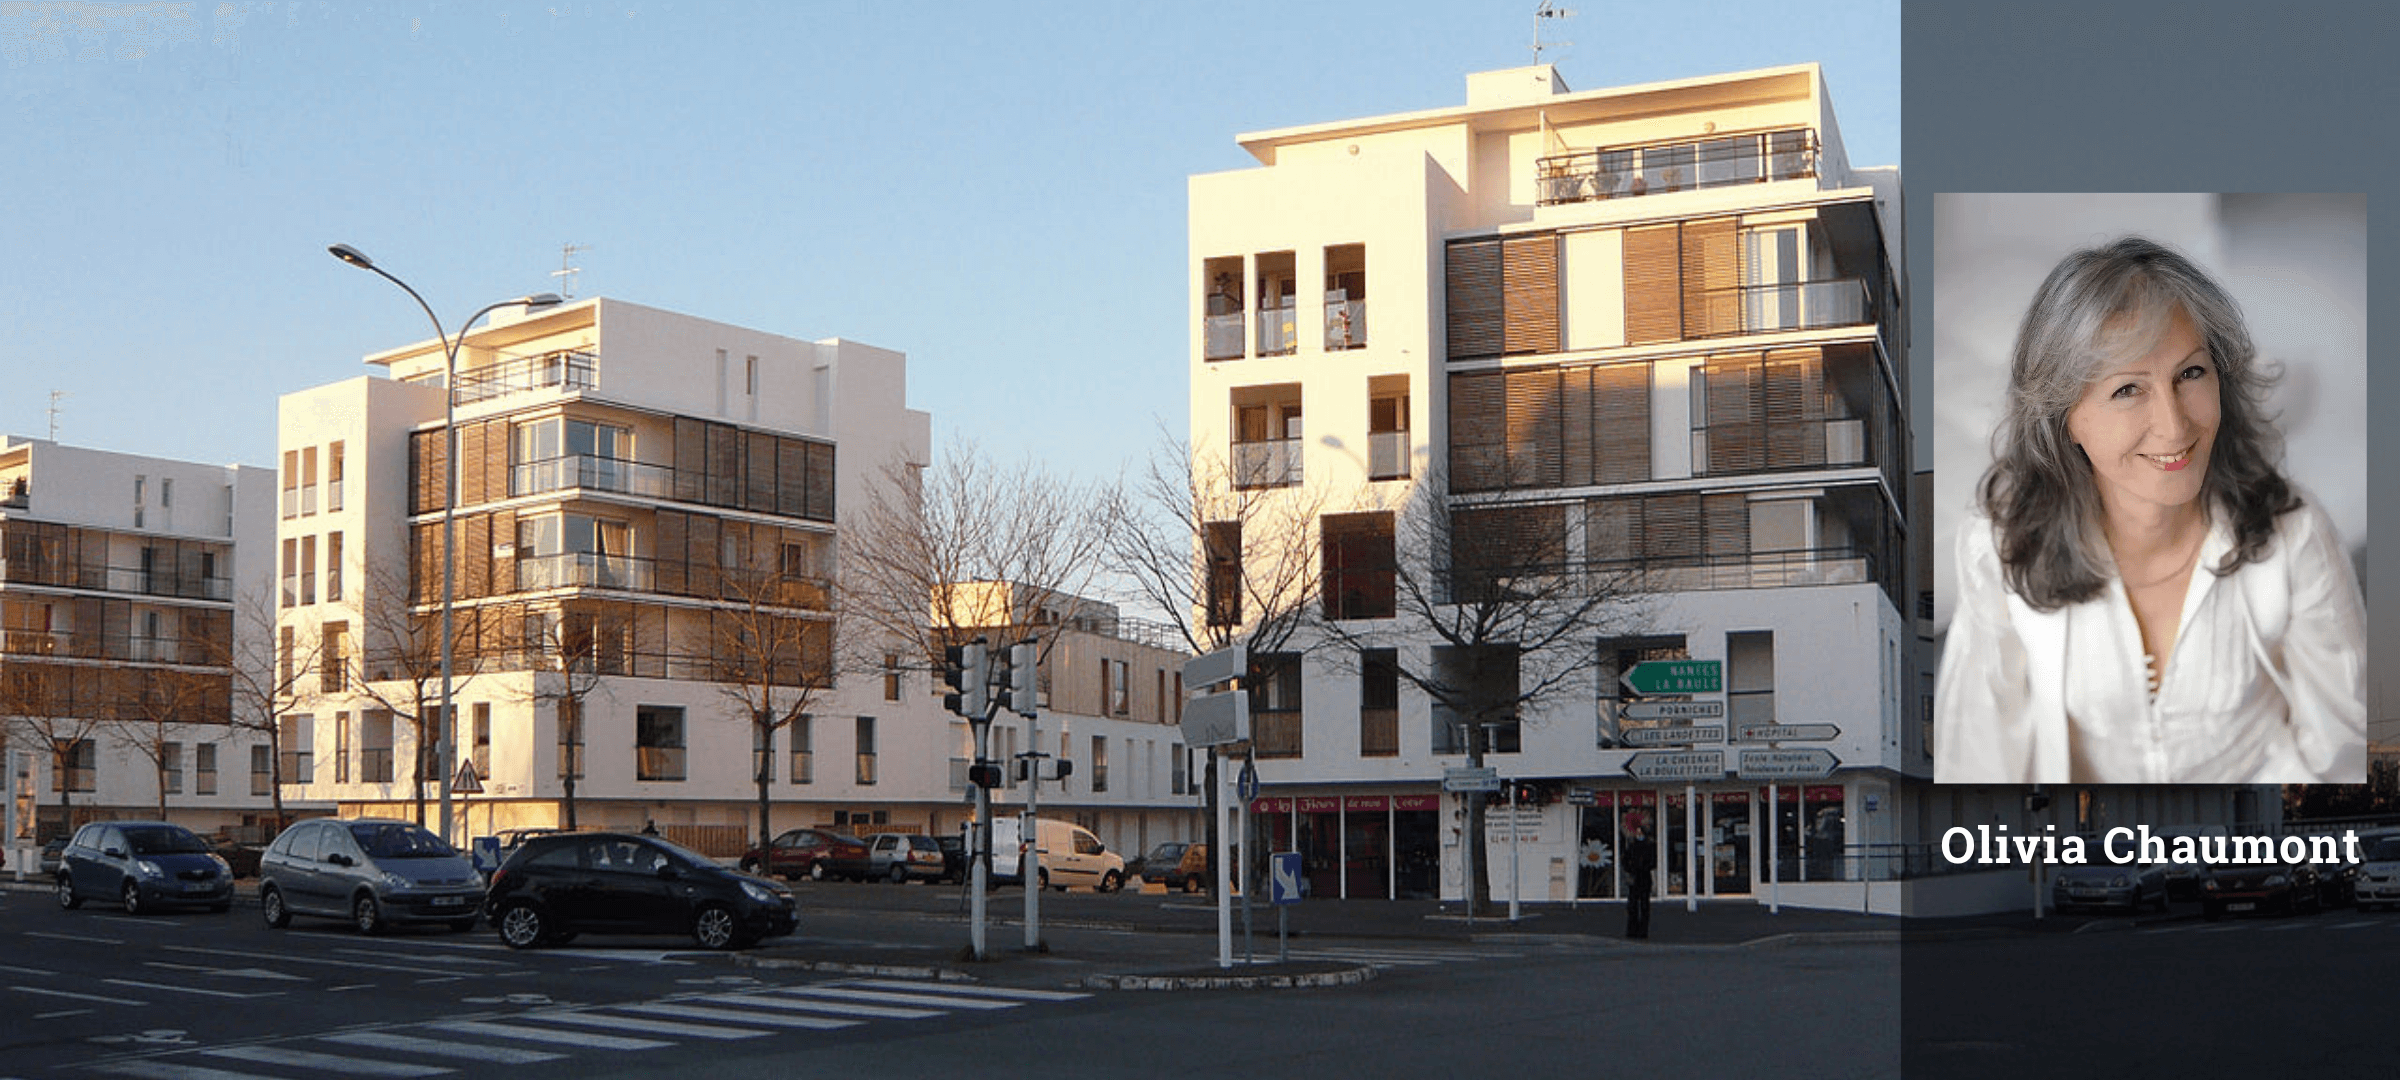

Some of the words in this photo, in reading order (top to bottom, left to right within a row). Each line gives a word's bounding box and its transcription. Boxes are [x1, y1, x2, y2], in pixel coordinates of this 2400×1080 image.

[1670, 664, 1718, 677] NANTES
[1656, 679, 1671, 690] LA
[1676, 677, 1718, 689] BAULE
[1660, 704, 1719, 714] PORNICHET
[1643, 730, 1661, 740] LES
[1656, 756, 1668, 765] LA
[1640, 767, 1651, 776] LA
